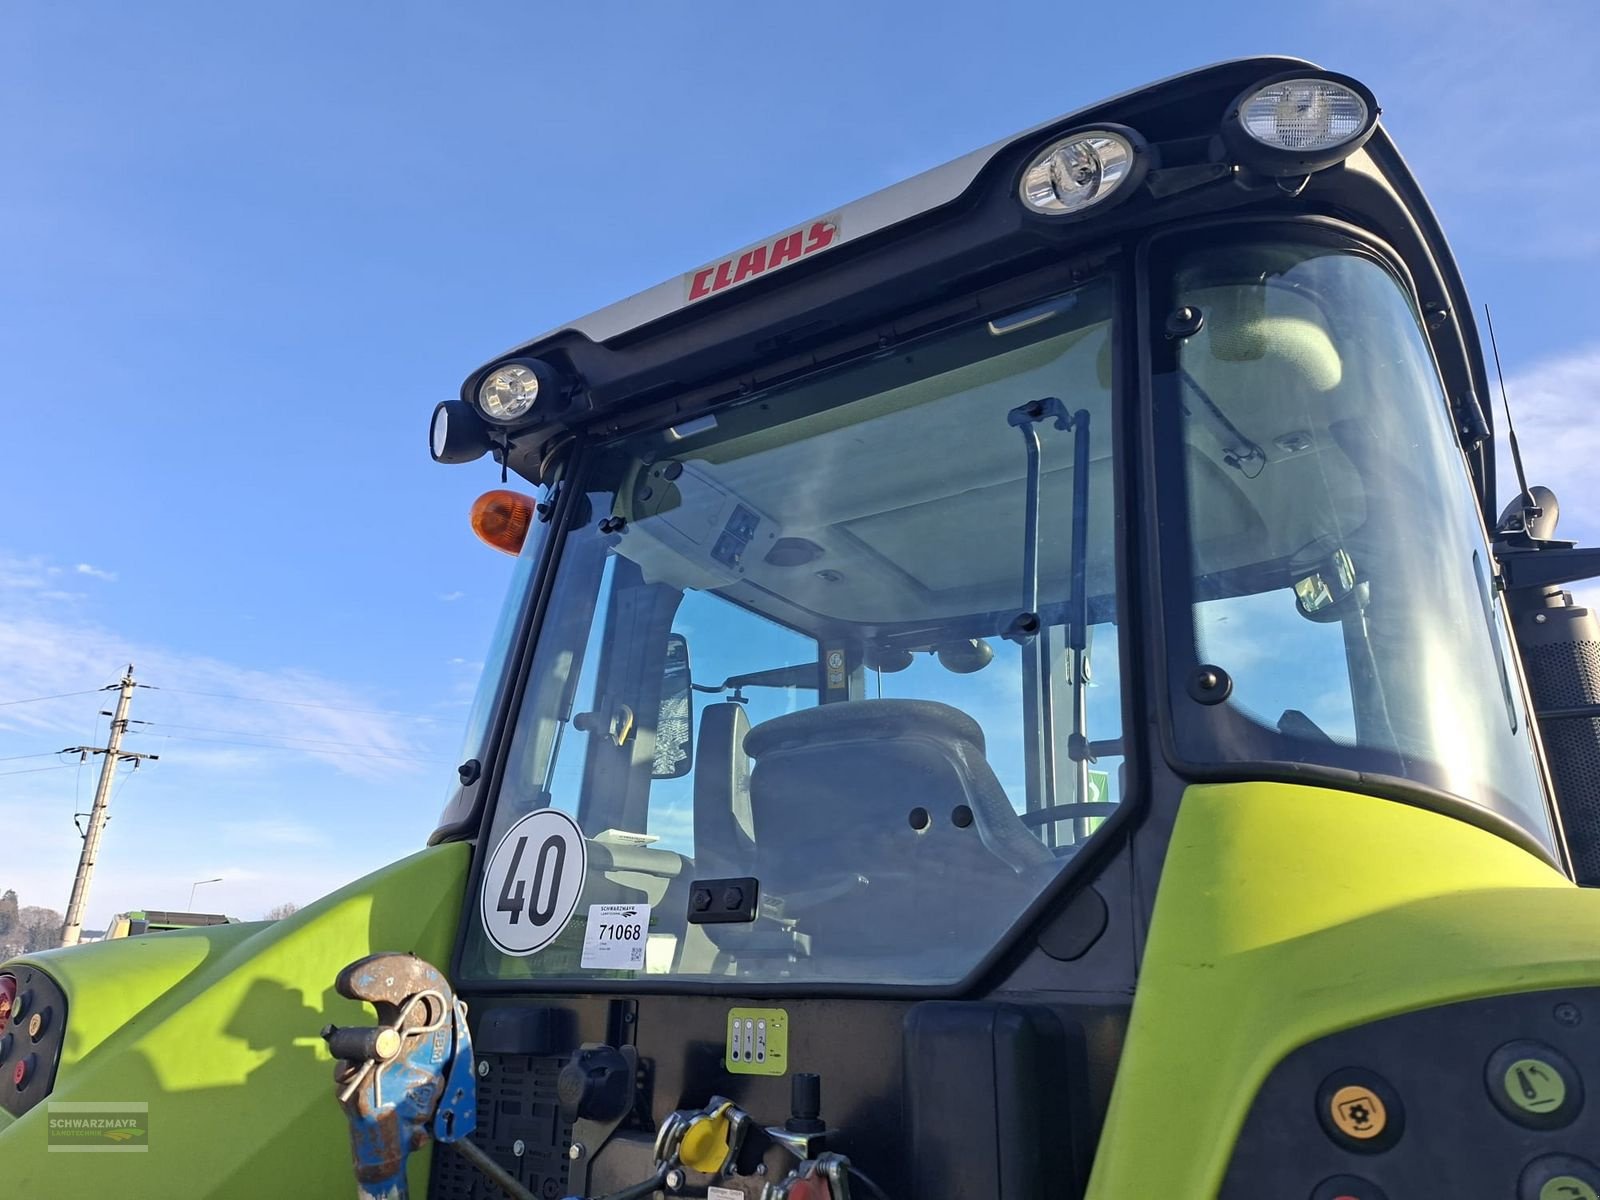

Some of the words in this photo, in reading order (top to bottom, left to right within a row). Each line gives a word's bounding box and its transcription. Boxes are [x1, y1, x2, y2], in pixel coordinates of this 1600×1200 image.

[688, 222, 837, 301] CLAAS
[496, 834, 567, 927] 40
[599, 924, 641, 940] 71068
